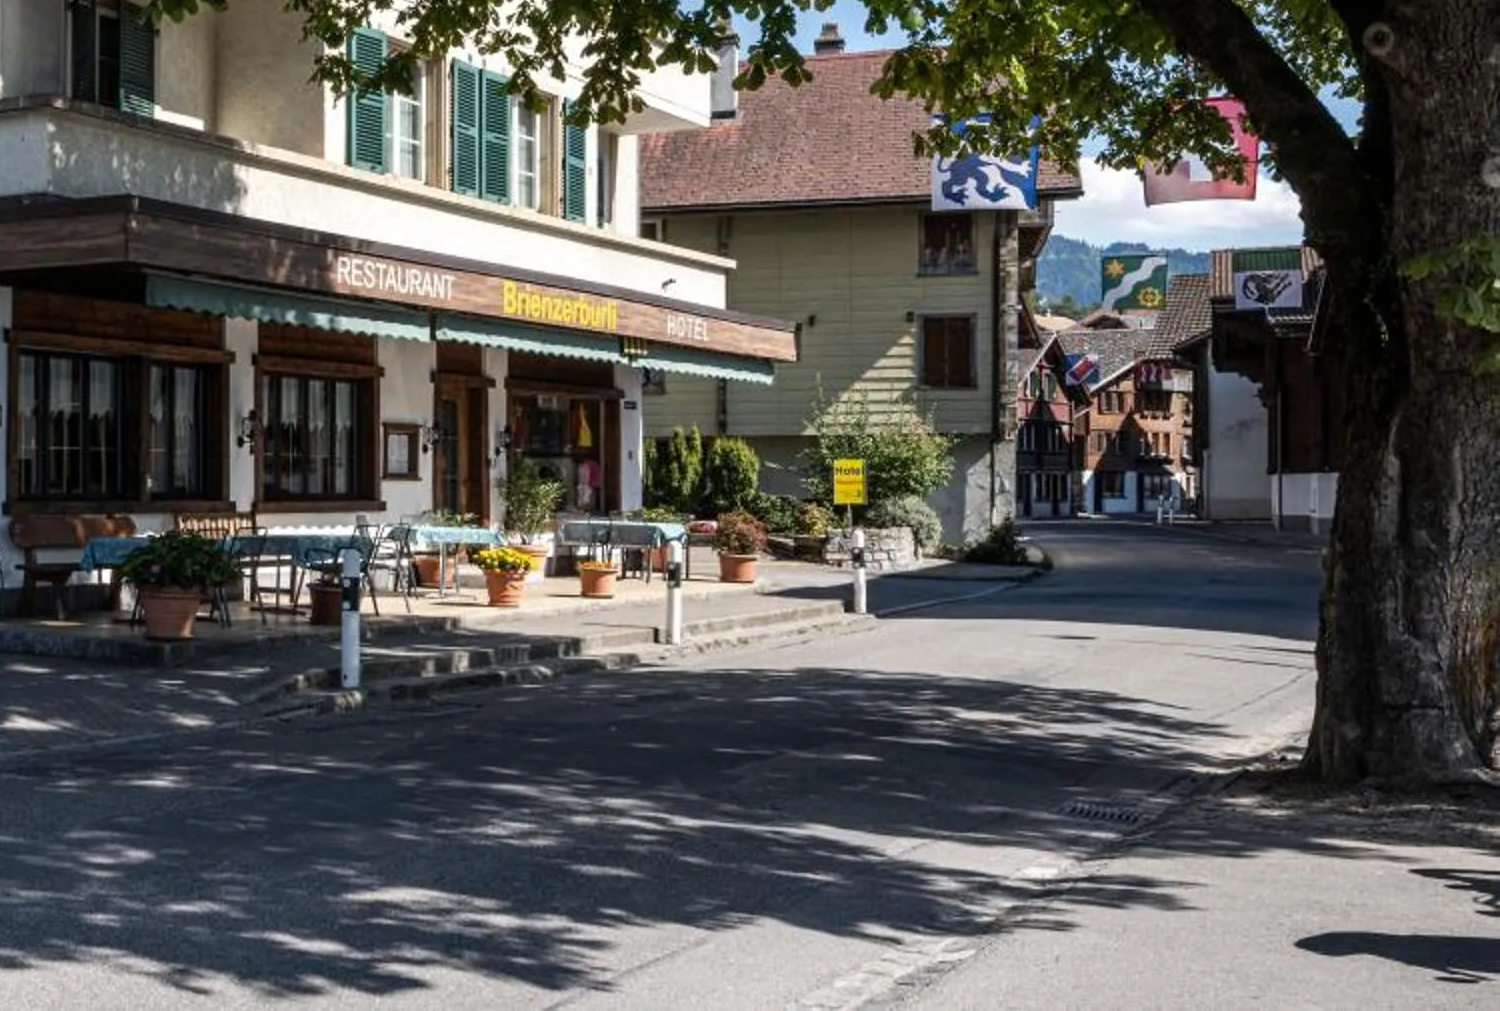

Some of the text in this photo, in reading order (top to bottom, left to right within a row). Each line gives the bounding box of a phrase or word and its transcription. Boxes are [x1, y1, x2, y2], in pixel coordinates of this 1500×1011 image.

[336, 255, 709, 342] RESTAURANT Brienzerburli HOTEL
